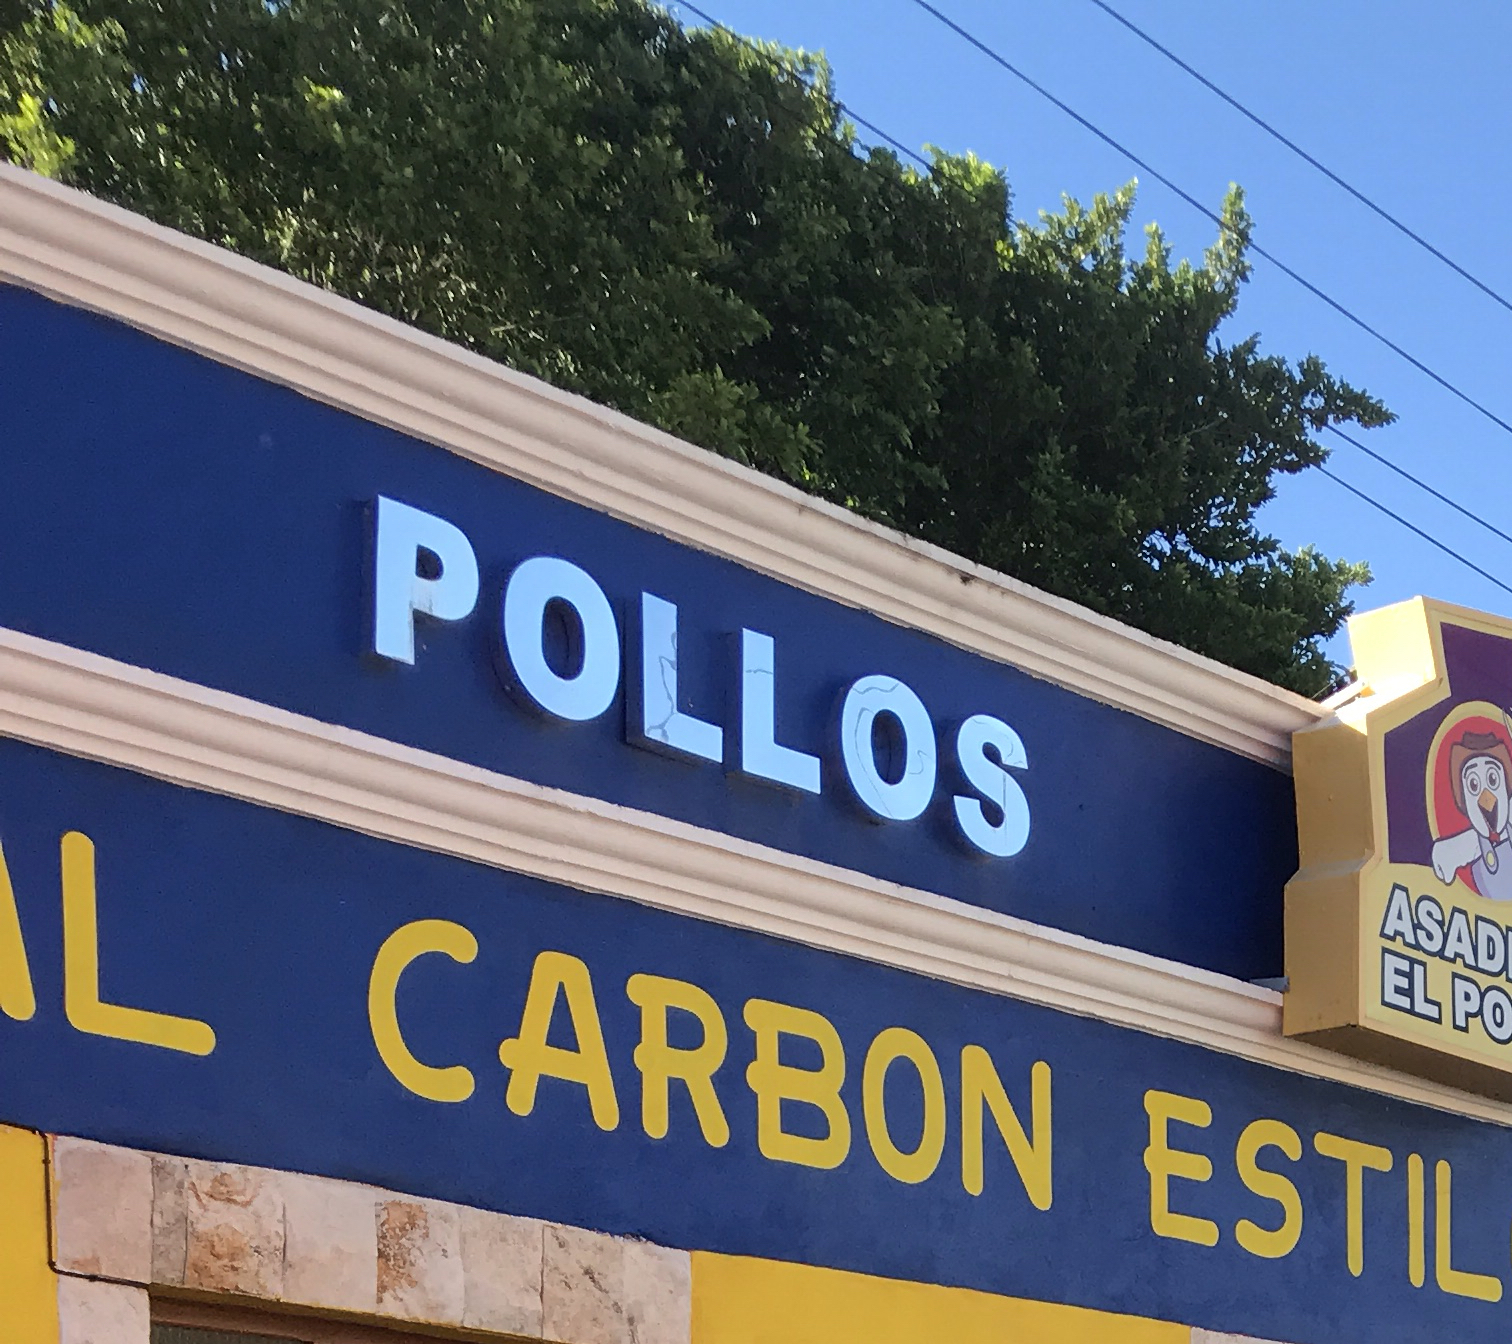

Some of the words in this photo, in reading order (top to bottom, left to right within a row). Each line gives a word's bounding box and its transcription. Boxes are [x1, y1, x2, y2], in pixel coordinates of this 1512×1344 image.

[370, 494, 1030, 857] POLLOS
[368, 919, 1052, 1210] CARBON
[1381, 946, 1442, 1024] EL
